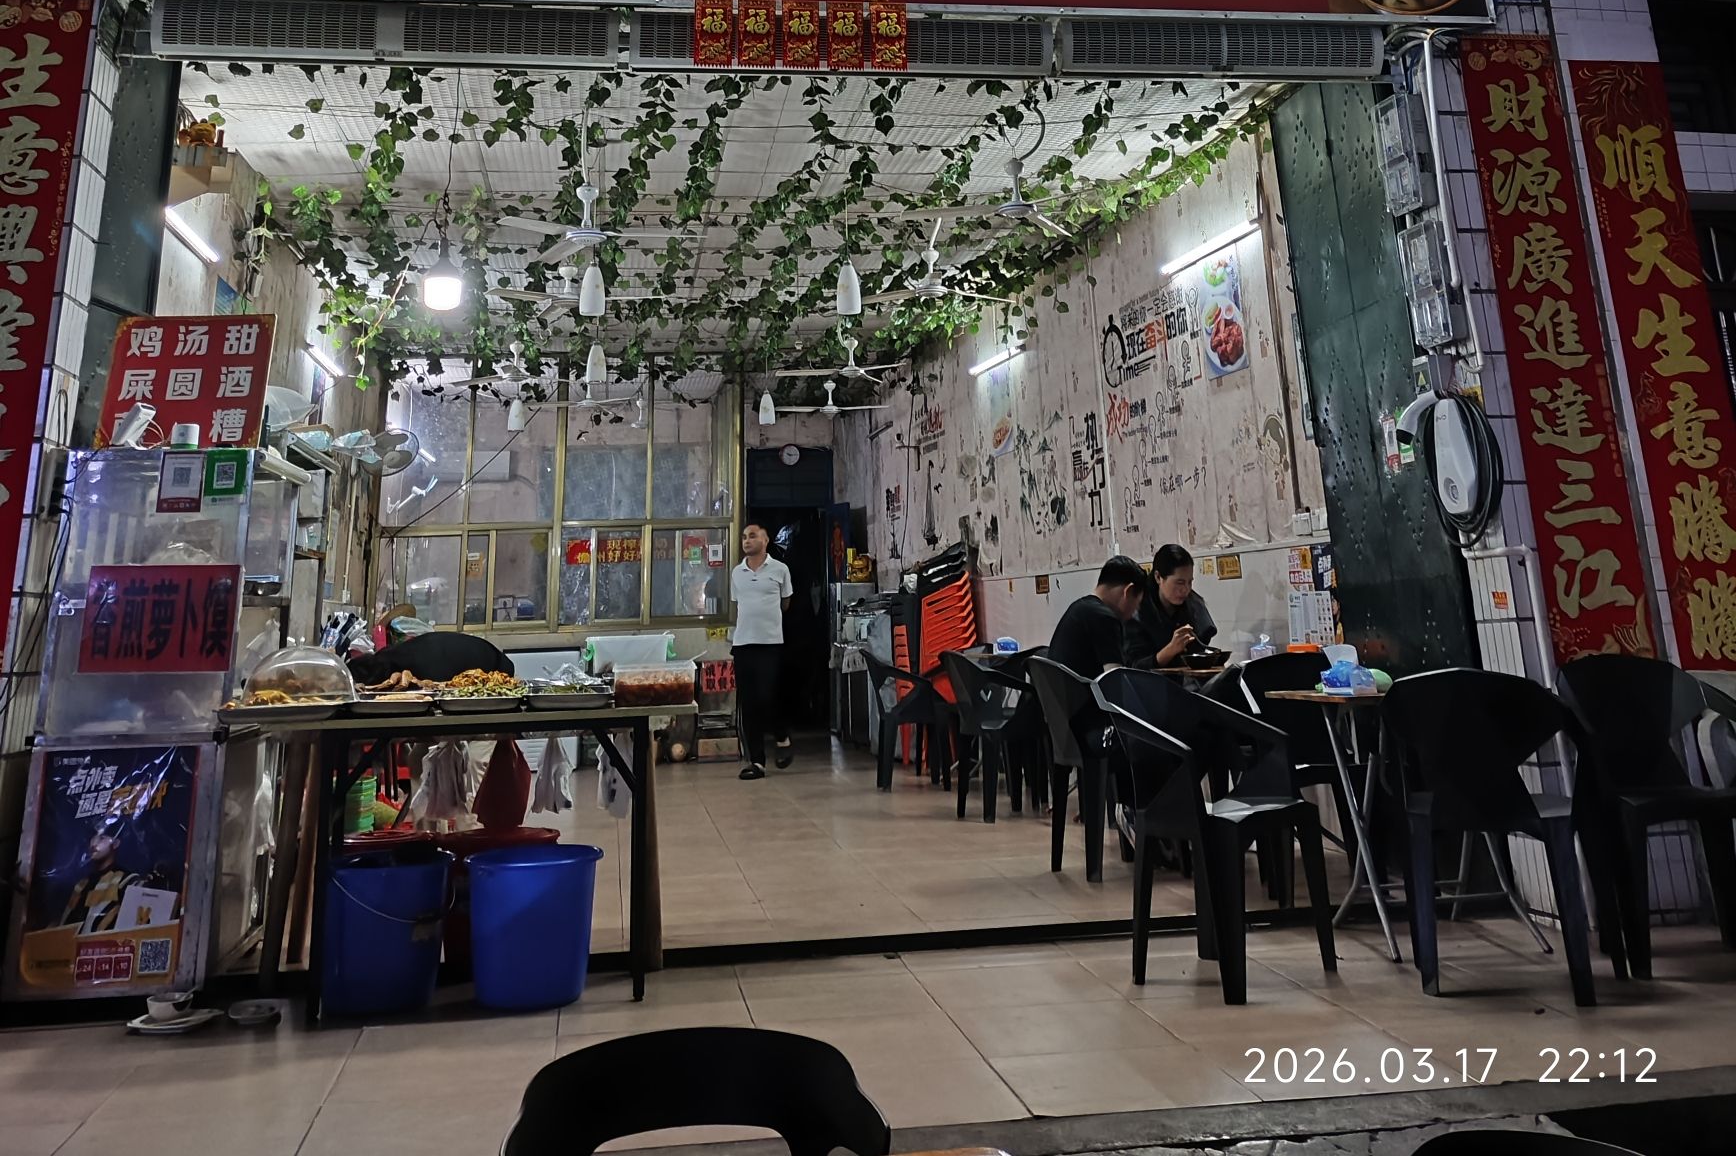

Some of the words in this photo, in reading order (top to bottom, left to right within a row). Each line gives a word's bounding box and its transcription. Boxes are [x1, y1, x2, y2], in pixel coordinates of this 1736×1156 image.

[701, 8, 728, 34] 福
[744, 8, 770, 35] 福
[788, 10, 814, 36] 福
[833, 11, 858, 37] 福
[877, 12, 902, 38] 福
[1482, 75, 1635, 619] 財源廣進達三江
